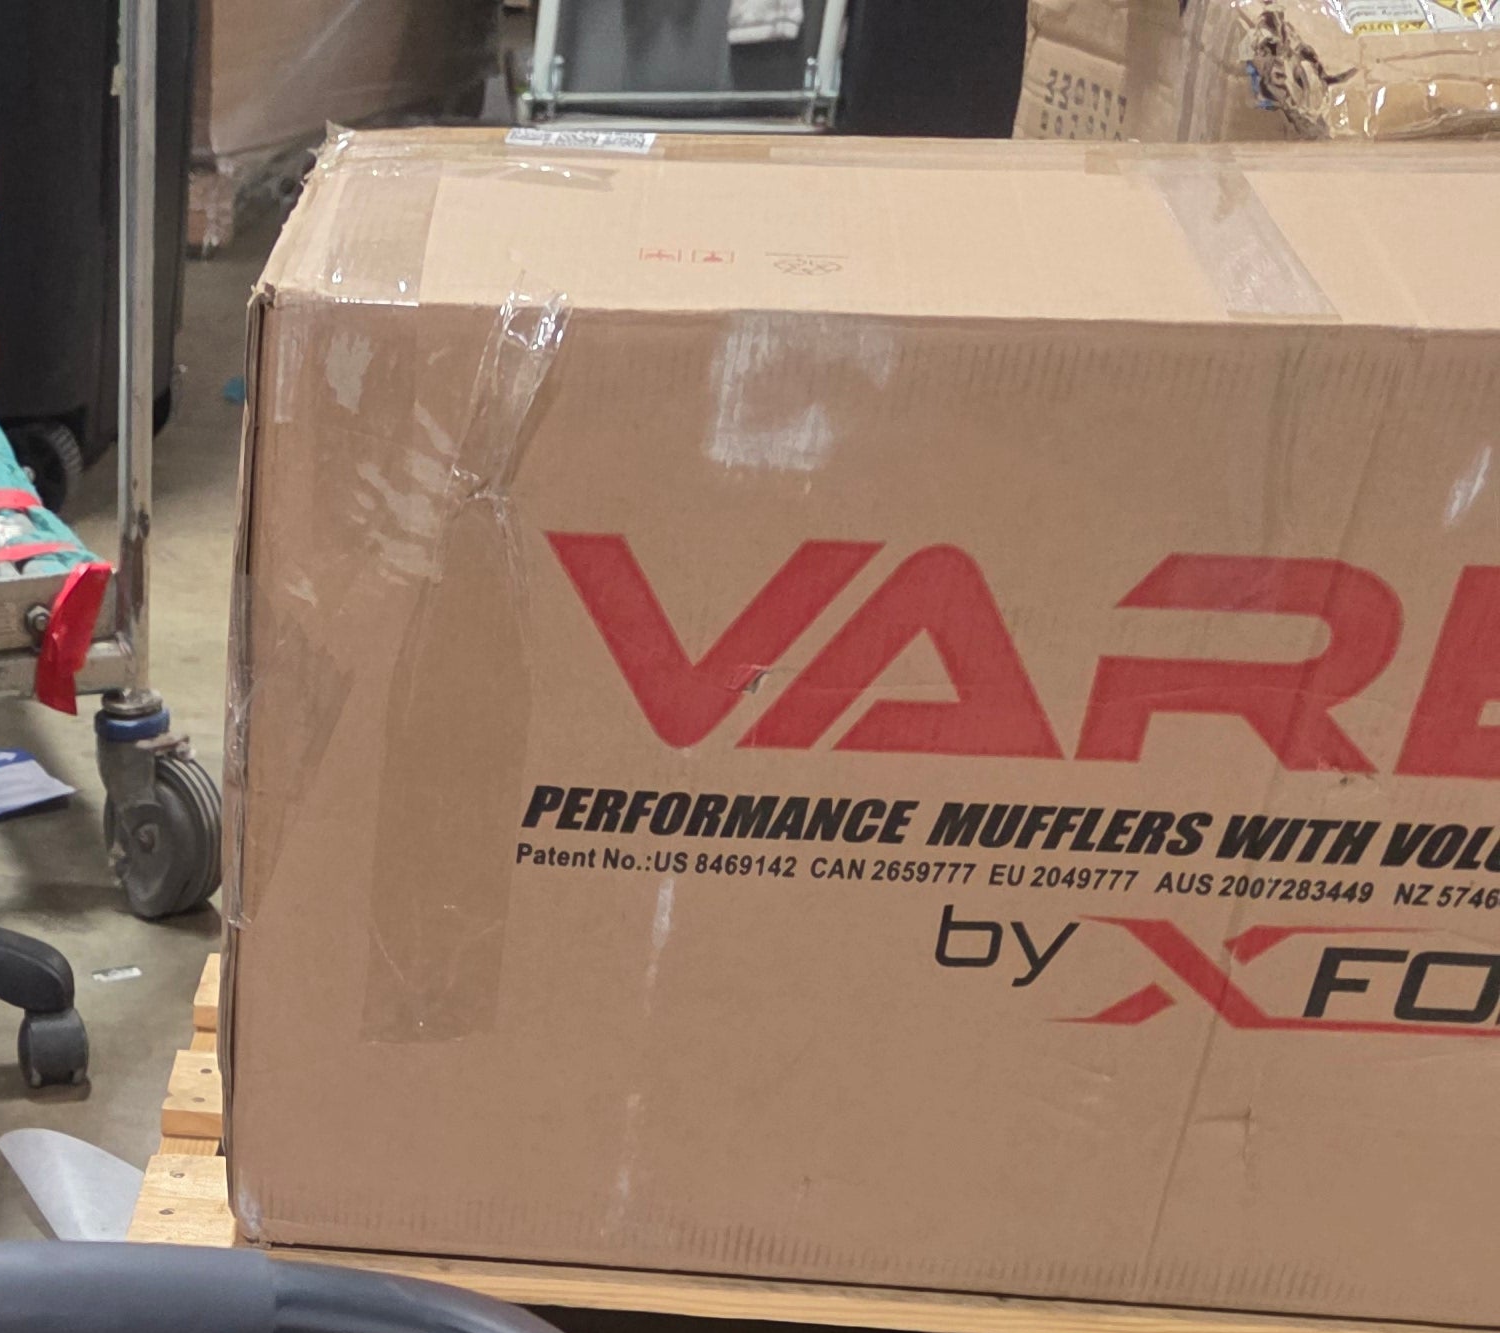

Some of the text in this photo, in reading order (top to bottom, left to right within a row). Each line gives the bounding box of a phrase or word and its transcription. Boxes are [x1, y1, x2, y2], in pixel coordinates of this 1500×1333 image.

[521, 785, 920, 844] PERFORMANCE
[925, 801, 1214, 857] MUFFLERS
[1216, 814, 1382, 865] WITH
[516, 843, 596, 869] Patent
[695, 853, 798, 878] 8469142
[810, 857, 866, 881] CAN
[871, 861, 977, 885] 2659777
[988, 864, 1025, 886] EU
[1033, 866, 1138, 892] 2049777
[1154, 871, 1214, 896] AUS
[1219, 874, 1374, 903] 2007283449
[1393, 883, 1434, 906] NZ
[1437, 885, 1500, 910] 5746
[935, 904, 1080, 987] by
[1043, 915, 1500, 1037] XFO
